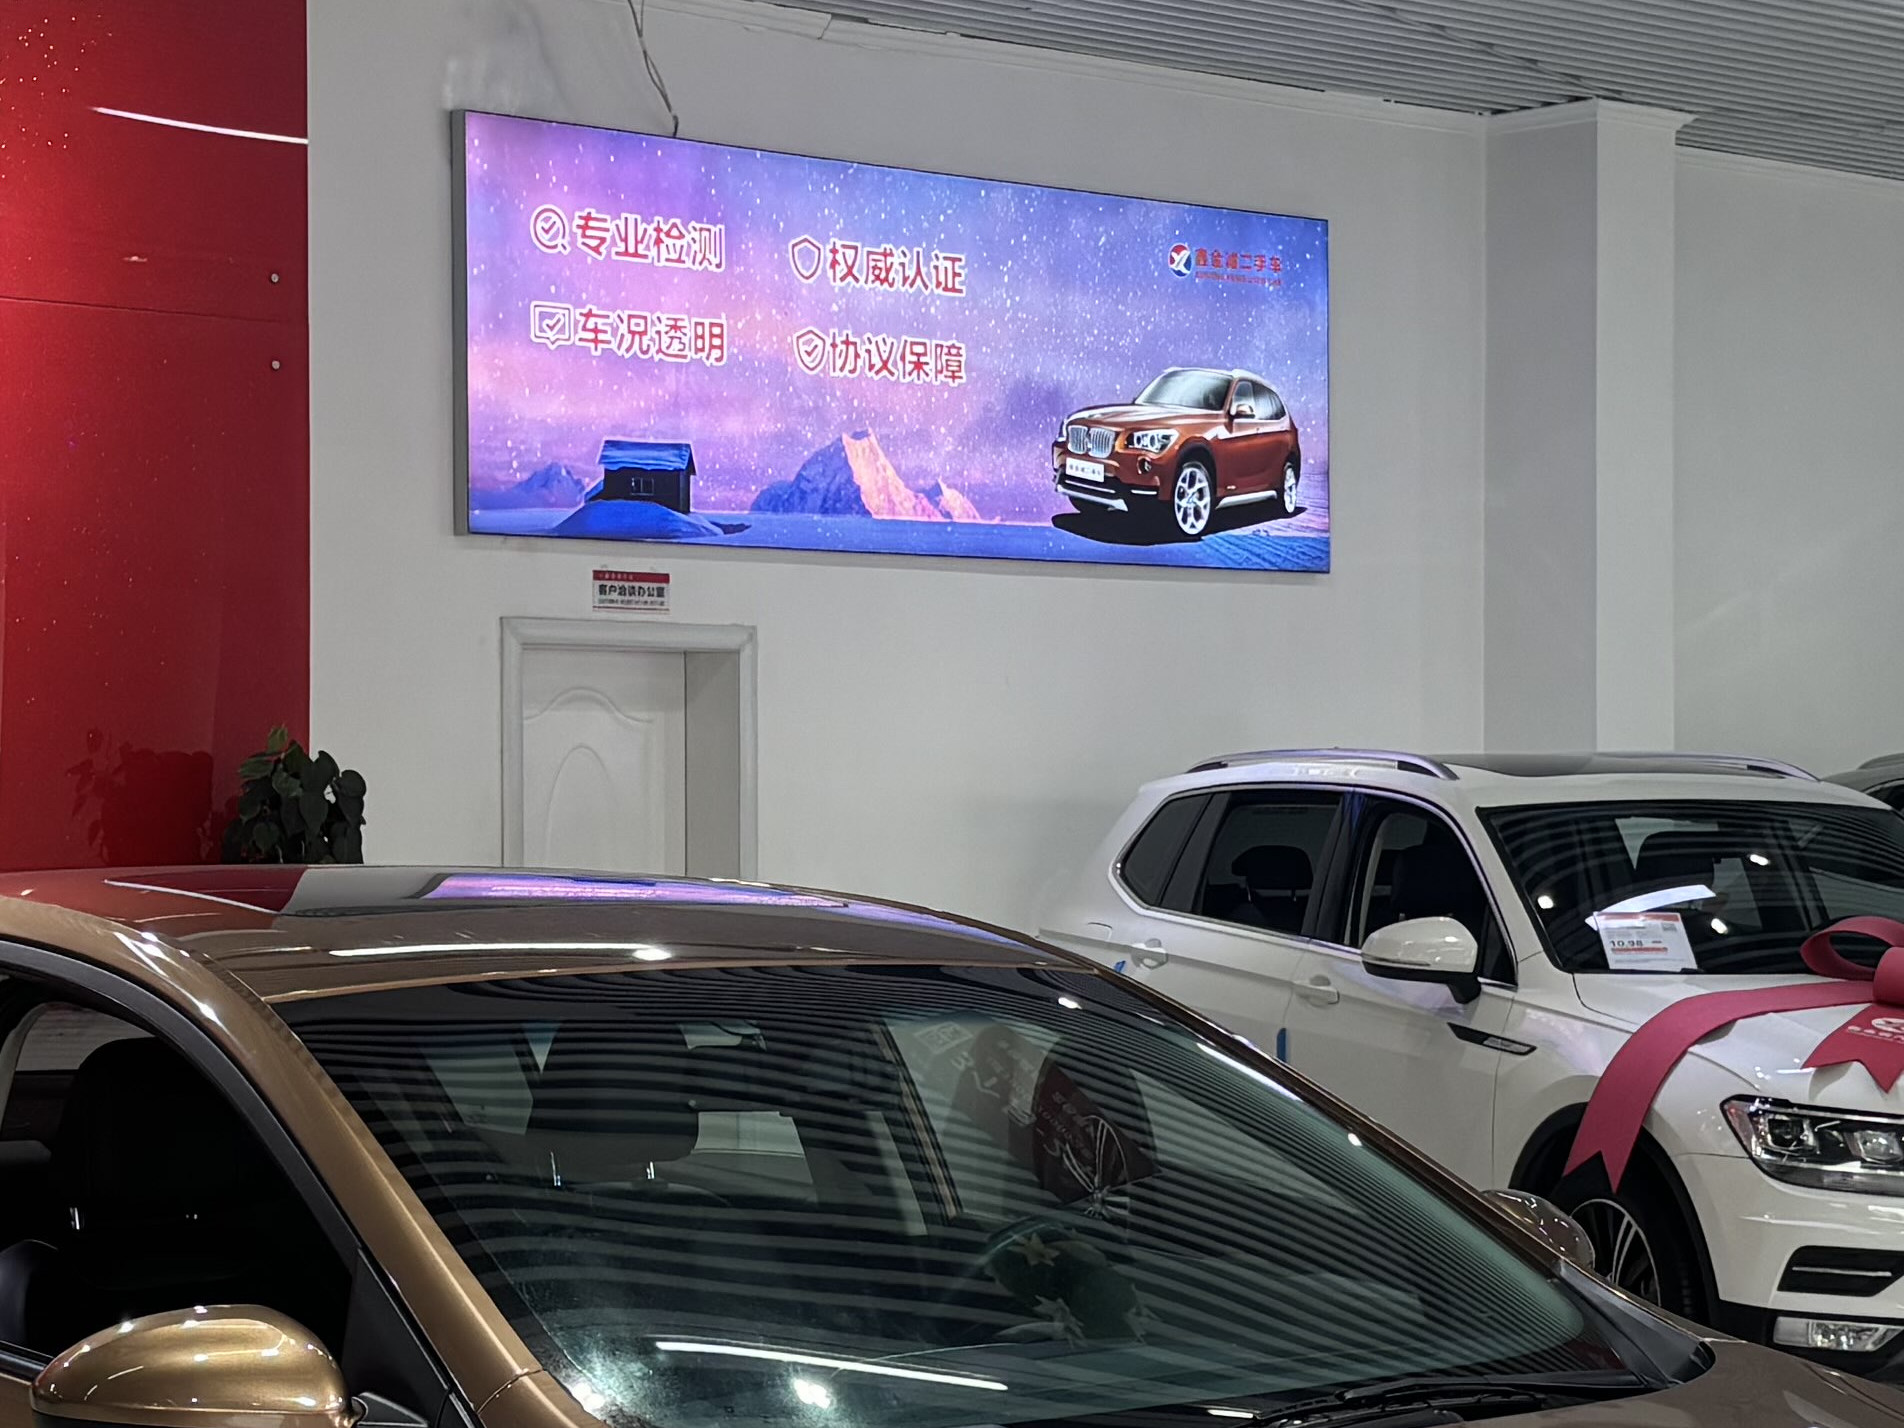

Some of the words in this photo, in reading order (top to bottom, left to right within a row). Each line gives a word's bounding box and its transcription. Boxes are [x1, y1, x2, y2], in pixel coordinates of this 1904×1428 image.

[573, 208, 727, 273] 专业检测
[826, 237, 967, 299] 权威认证
[574, 304, 729, 368] 车况透明
[827, 328, 967, 387] 协议保障
